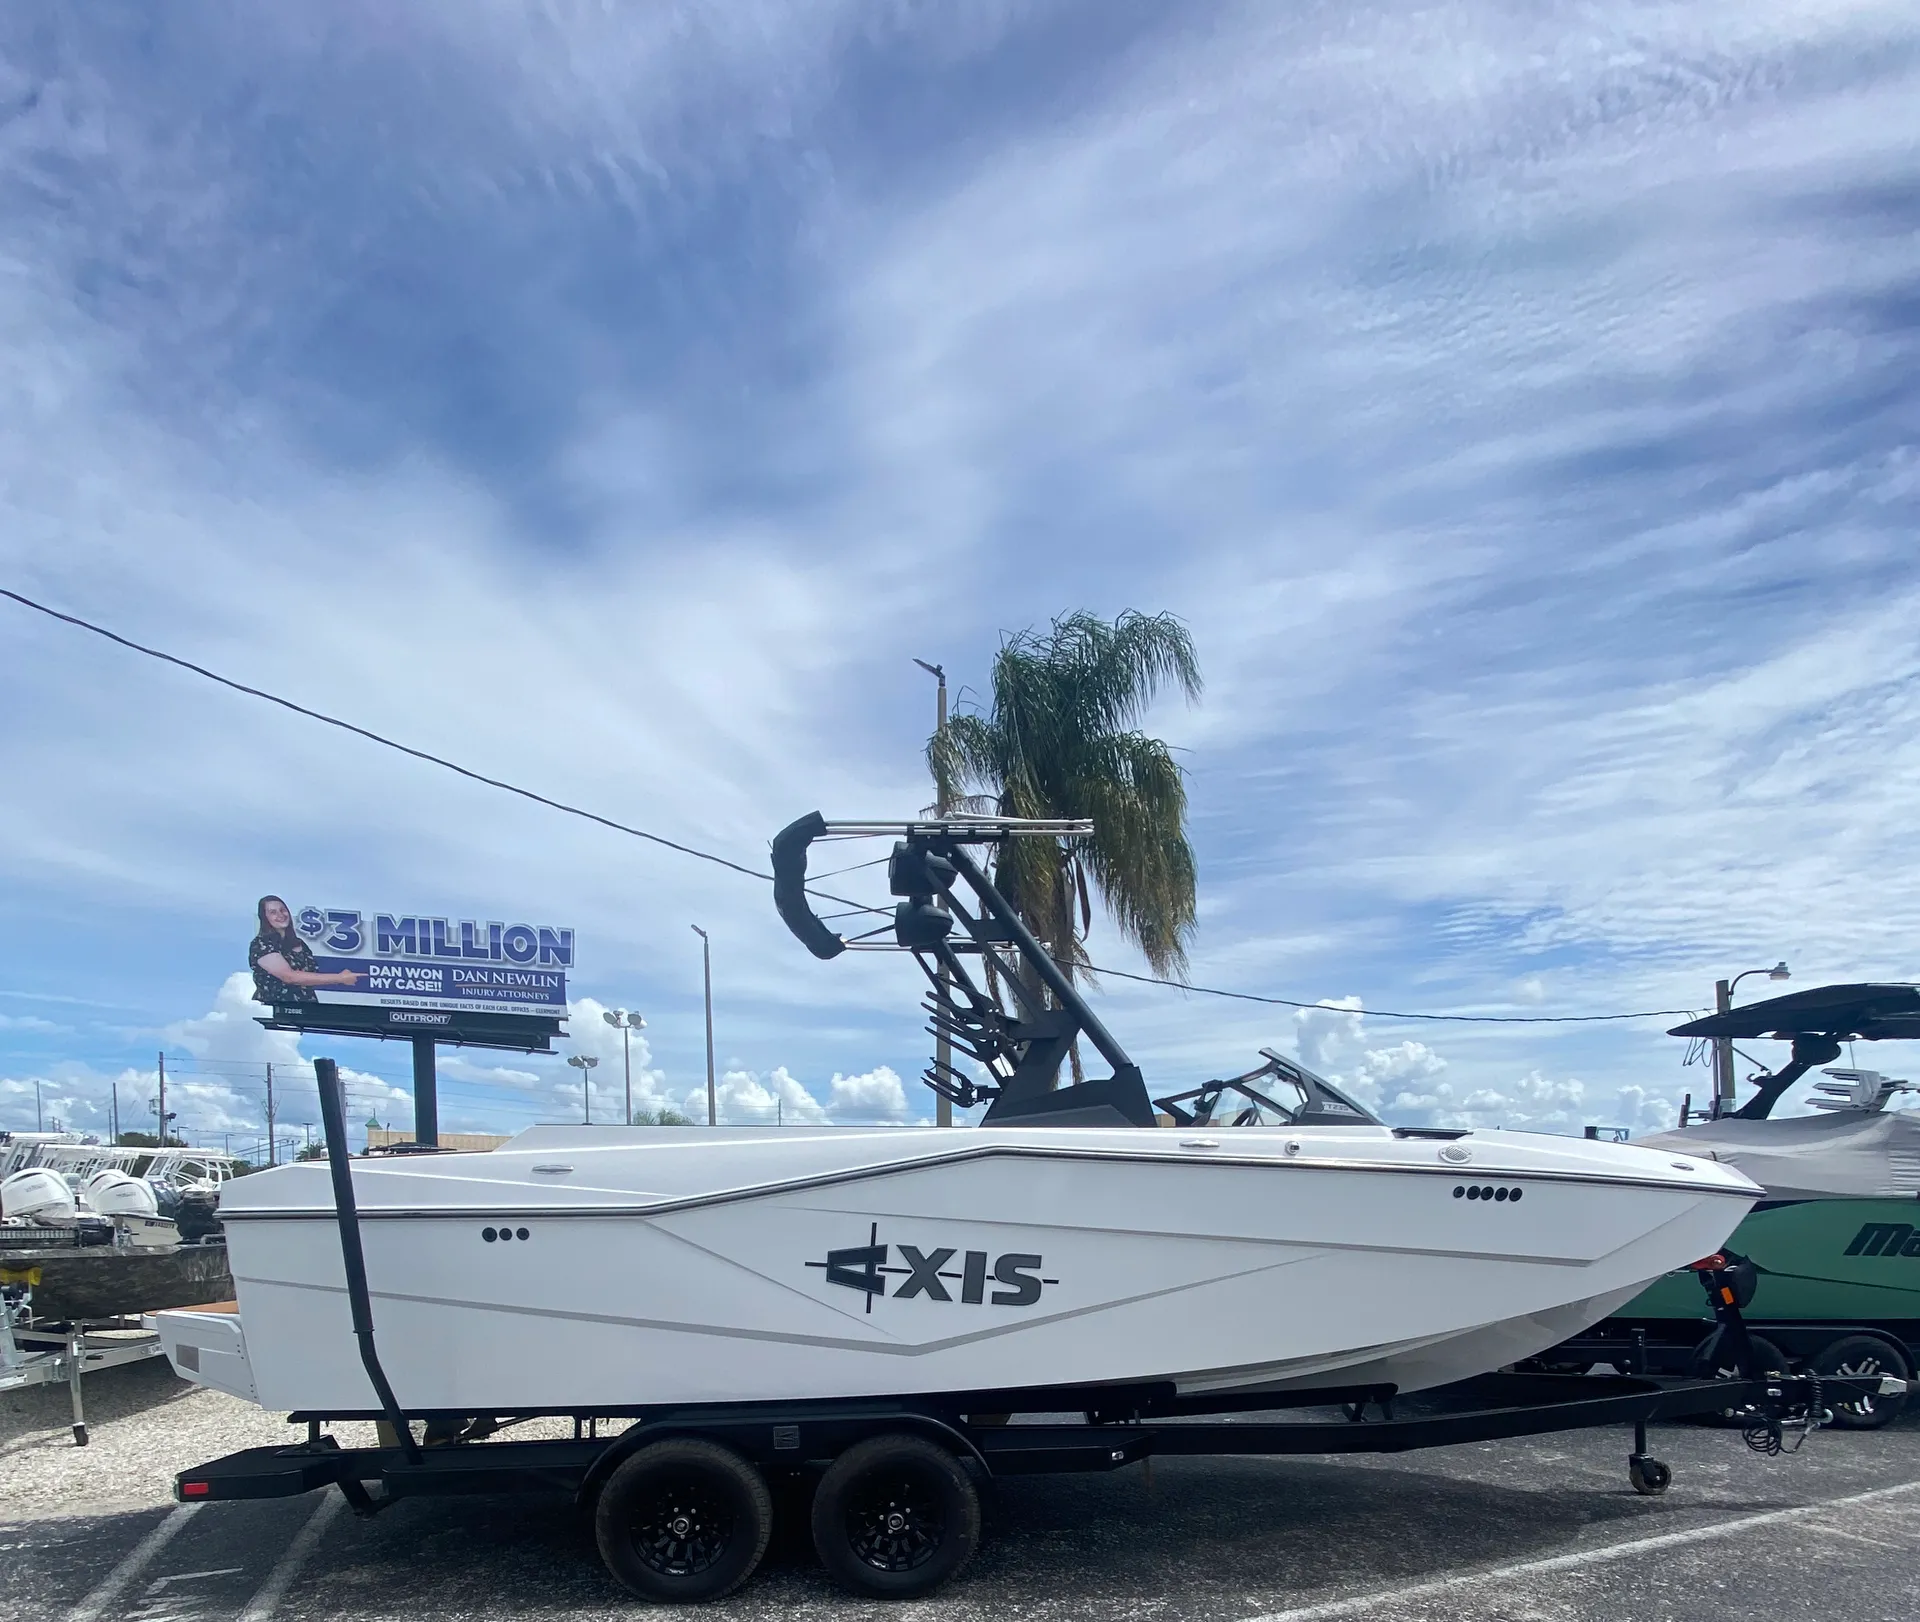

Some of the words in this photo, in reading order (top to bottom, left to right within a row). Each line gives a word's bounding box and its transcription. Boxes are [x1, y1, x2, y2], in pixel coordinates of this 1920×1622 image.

[297, 906, 362, 953] $3
[375, 913, 573, 966] MILLION
[369, 965, 402, 977] DAN
[405, 967, 443, 981] WON
[452, 968, 489, 984] DAN
[493, 972, 560, 988] NEWLIN
[369, 977, 395, 989] MY
[395, 979, 442, 992] CASE!!
[462, 987, 495, 997] INJURY
[496, 990, 550, 1000] ATTORNEYS
[392, 1013, 448, 1023] OUTFRONT
[535, 1007, 560, 1015] CLERMONT
[826, 1243, 1043, 1306] AXIS
